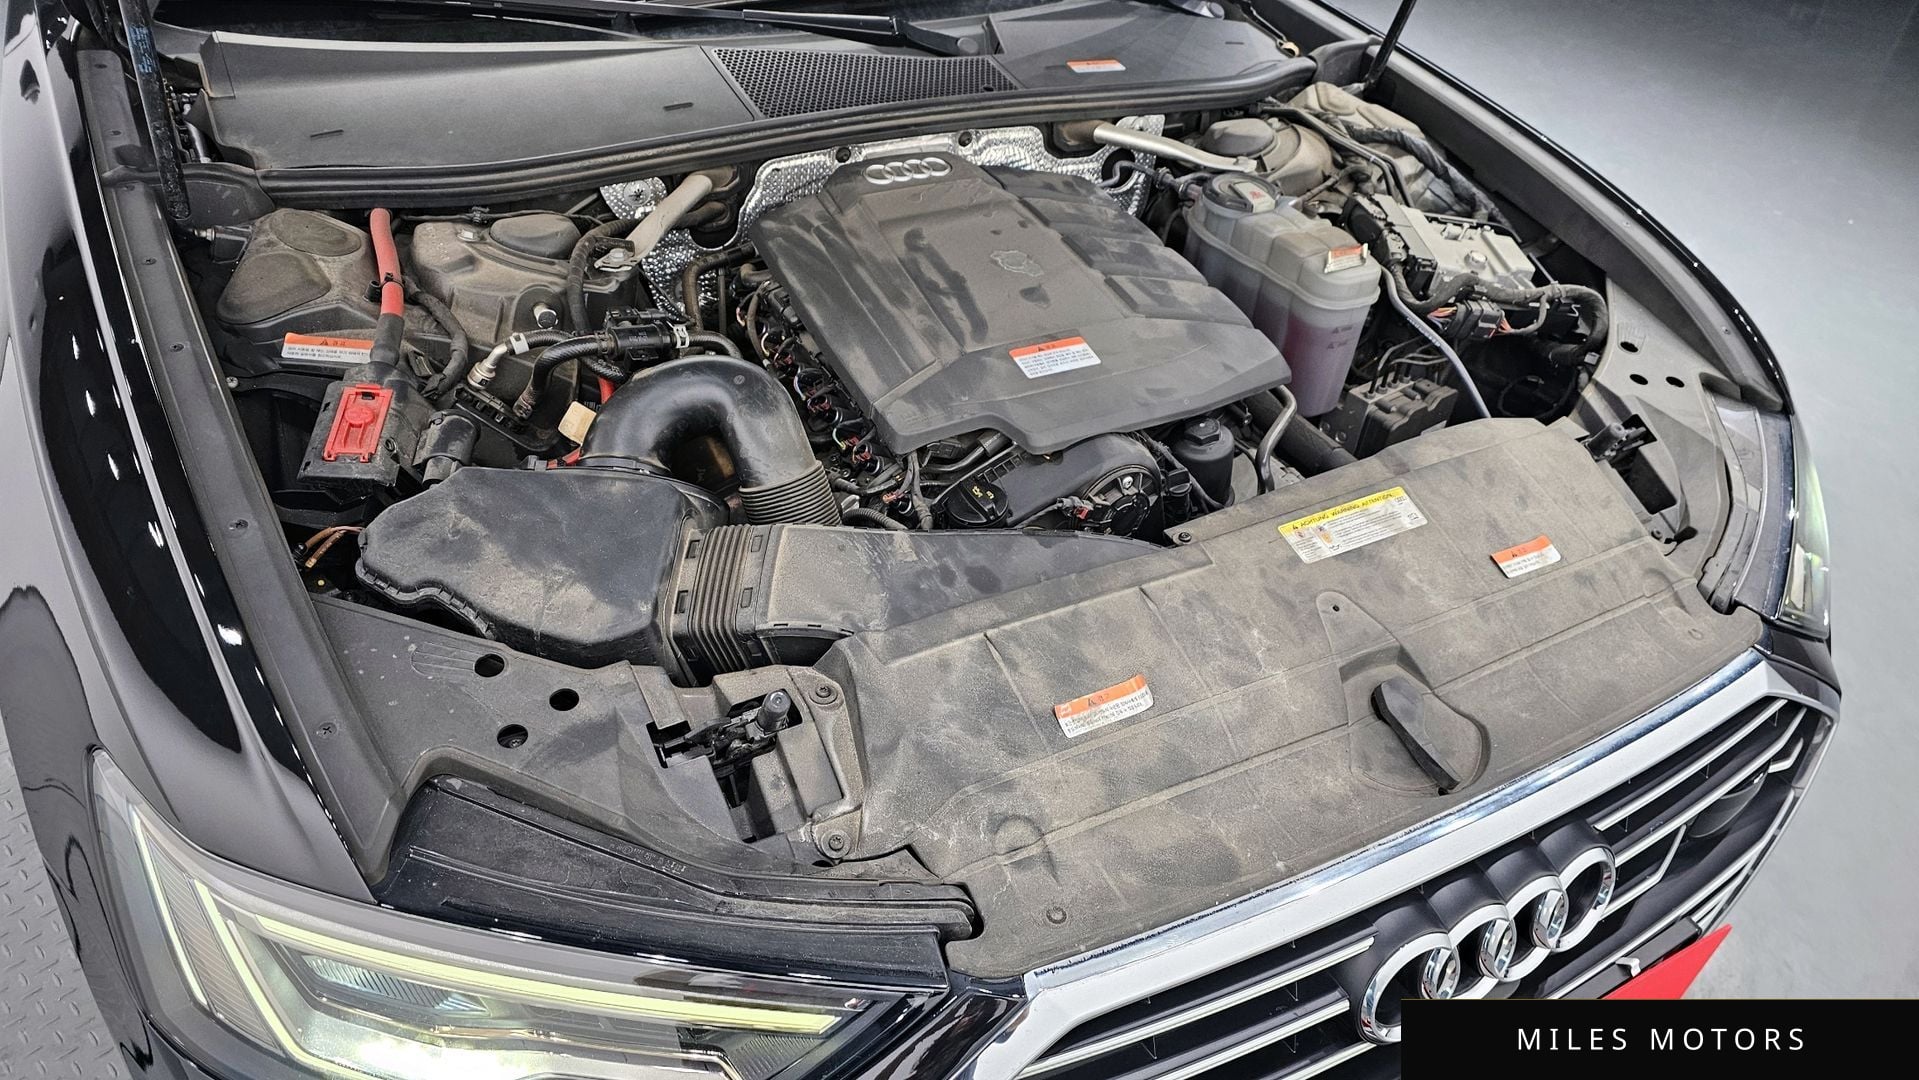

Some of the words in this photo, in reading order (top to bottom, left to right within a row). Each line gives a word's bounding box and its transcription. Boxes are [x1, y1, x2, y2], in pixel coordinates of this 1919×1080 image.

[1300, 514, 1329, 527] ACHTUNG
[1332, 504, 1360, 517] WARNING
[1361, 493, 1393, 507] ATTENTION
